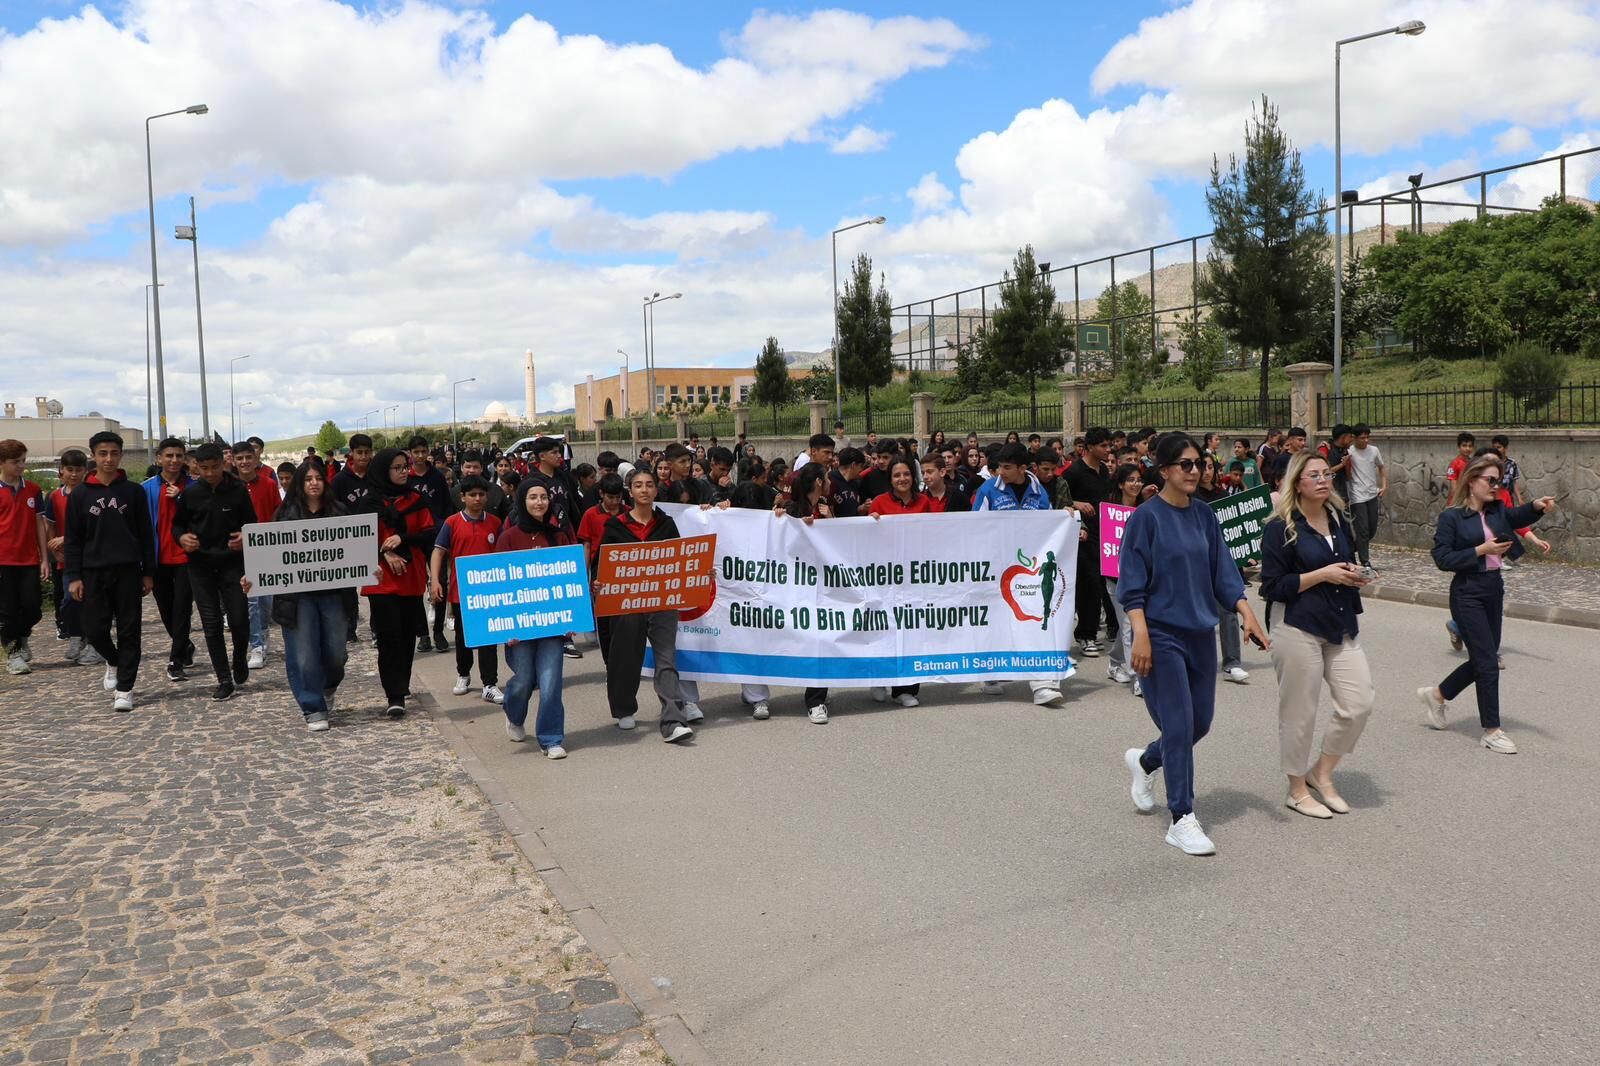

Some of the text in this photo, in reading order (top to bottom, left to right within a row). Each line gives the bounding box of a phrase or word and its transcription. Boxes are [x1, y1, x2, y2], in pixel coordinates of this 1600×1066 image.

[89, 497, 128, 516] BTAL
[248, 524, 375, 547] Kalbimi Seviyorum.
[1223, 525, 1243, 542] Spor
[282, 547, 344, 565] Obeziteye
[608, 546, 675, 562] Sağlığın
[258, 564, 368, 588] Karşı Yürüyorum
[466, 567, 507, 585] Obezite
[525, 560, 577, 578] Mücadele
[615, 559, 700, 578] Hareket Et
[722, 556, 996, 587] Obezite İle Mücadele Ediyoruz.
[551, 585, 564, 600] 10
[566, 583, 583, 598] Bin
[664, 578, 680, 590] 10
[685, 575, 710, 588] Bin
[621, 593, 685, 609] Adım At.
[487, 609, 573, 632] Adım Yürüyoruz
[729, 601, 989, 631] Günde 10 Bin Adım Yürüyoruz
[913, 660, 959, 672] Batman
[972, 657, 1008, 670] Sağlık
